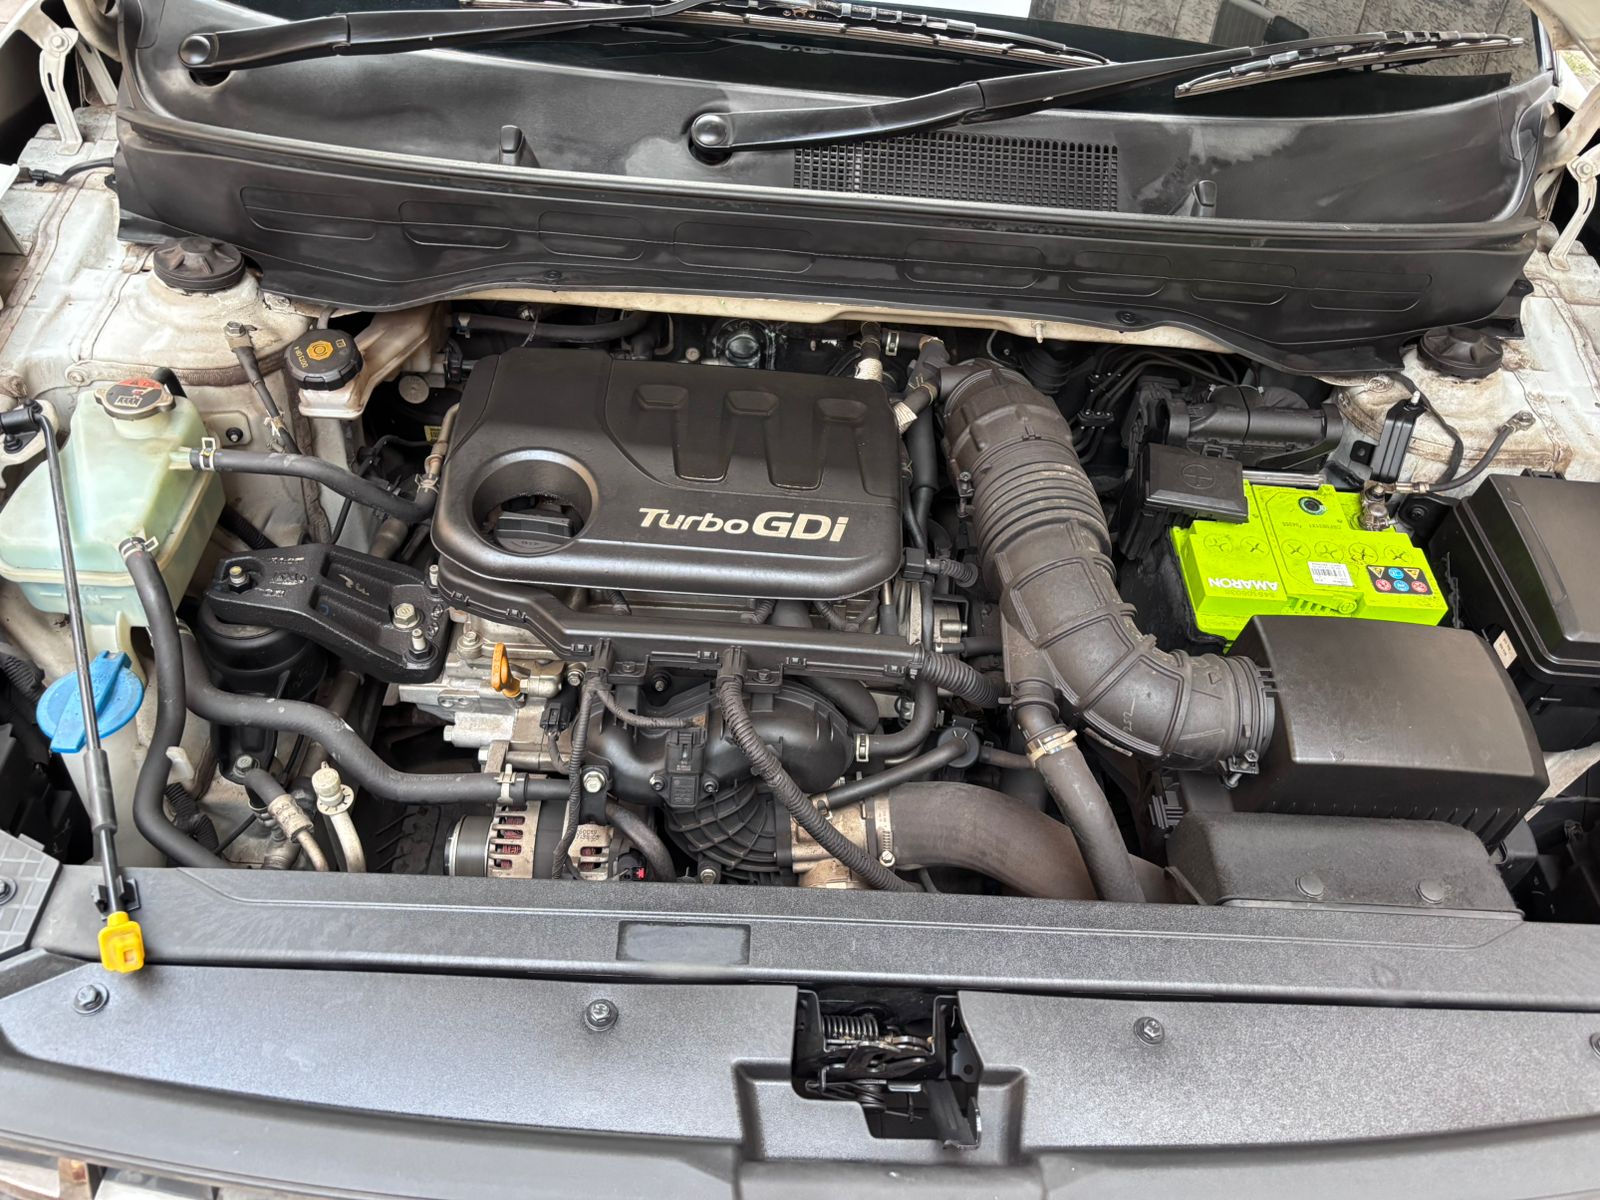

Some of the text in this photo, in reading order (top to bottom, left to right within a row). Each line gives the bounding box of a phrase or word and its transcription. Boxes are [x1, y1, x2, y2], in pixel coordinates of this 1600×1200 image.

[638, 507, 849, 542] Turbo GDi
[1208, 577, 1279, 592] AMARON
